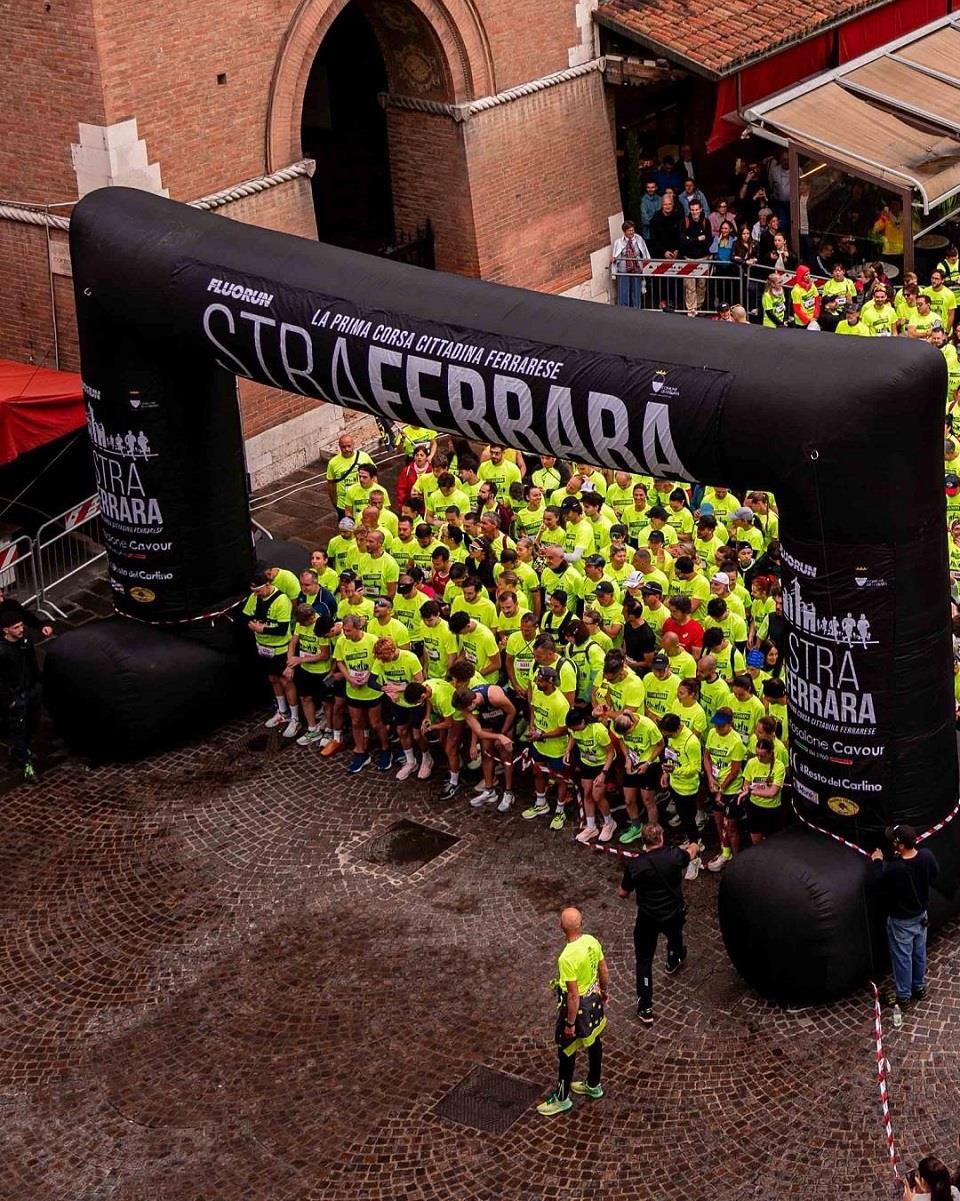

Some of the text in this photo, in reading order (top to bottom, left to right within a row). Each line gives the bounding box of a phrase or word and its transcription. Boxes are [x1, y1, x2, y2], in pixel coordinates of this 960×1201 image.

[207, 278, 274, 308] FLUORUN
[311, 309, 564, 380] LA PRIMA CORSA CITTADINA FERRARESE
[129, 540, 173, 551] Cavour
[789, 632, 859, 691] STRA
[832, 740, 885, 757] Cavour
[828, 777, 841, 787] del
[842, 779, 882, 792] Carlino
